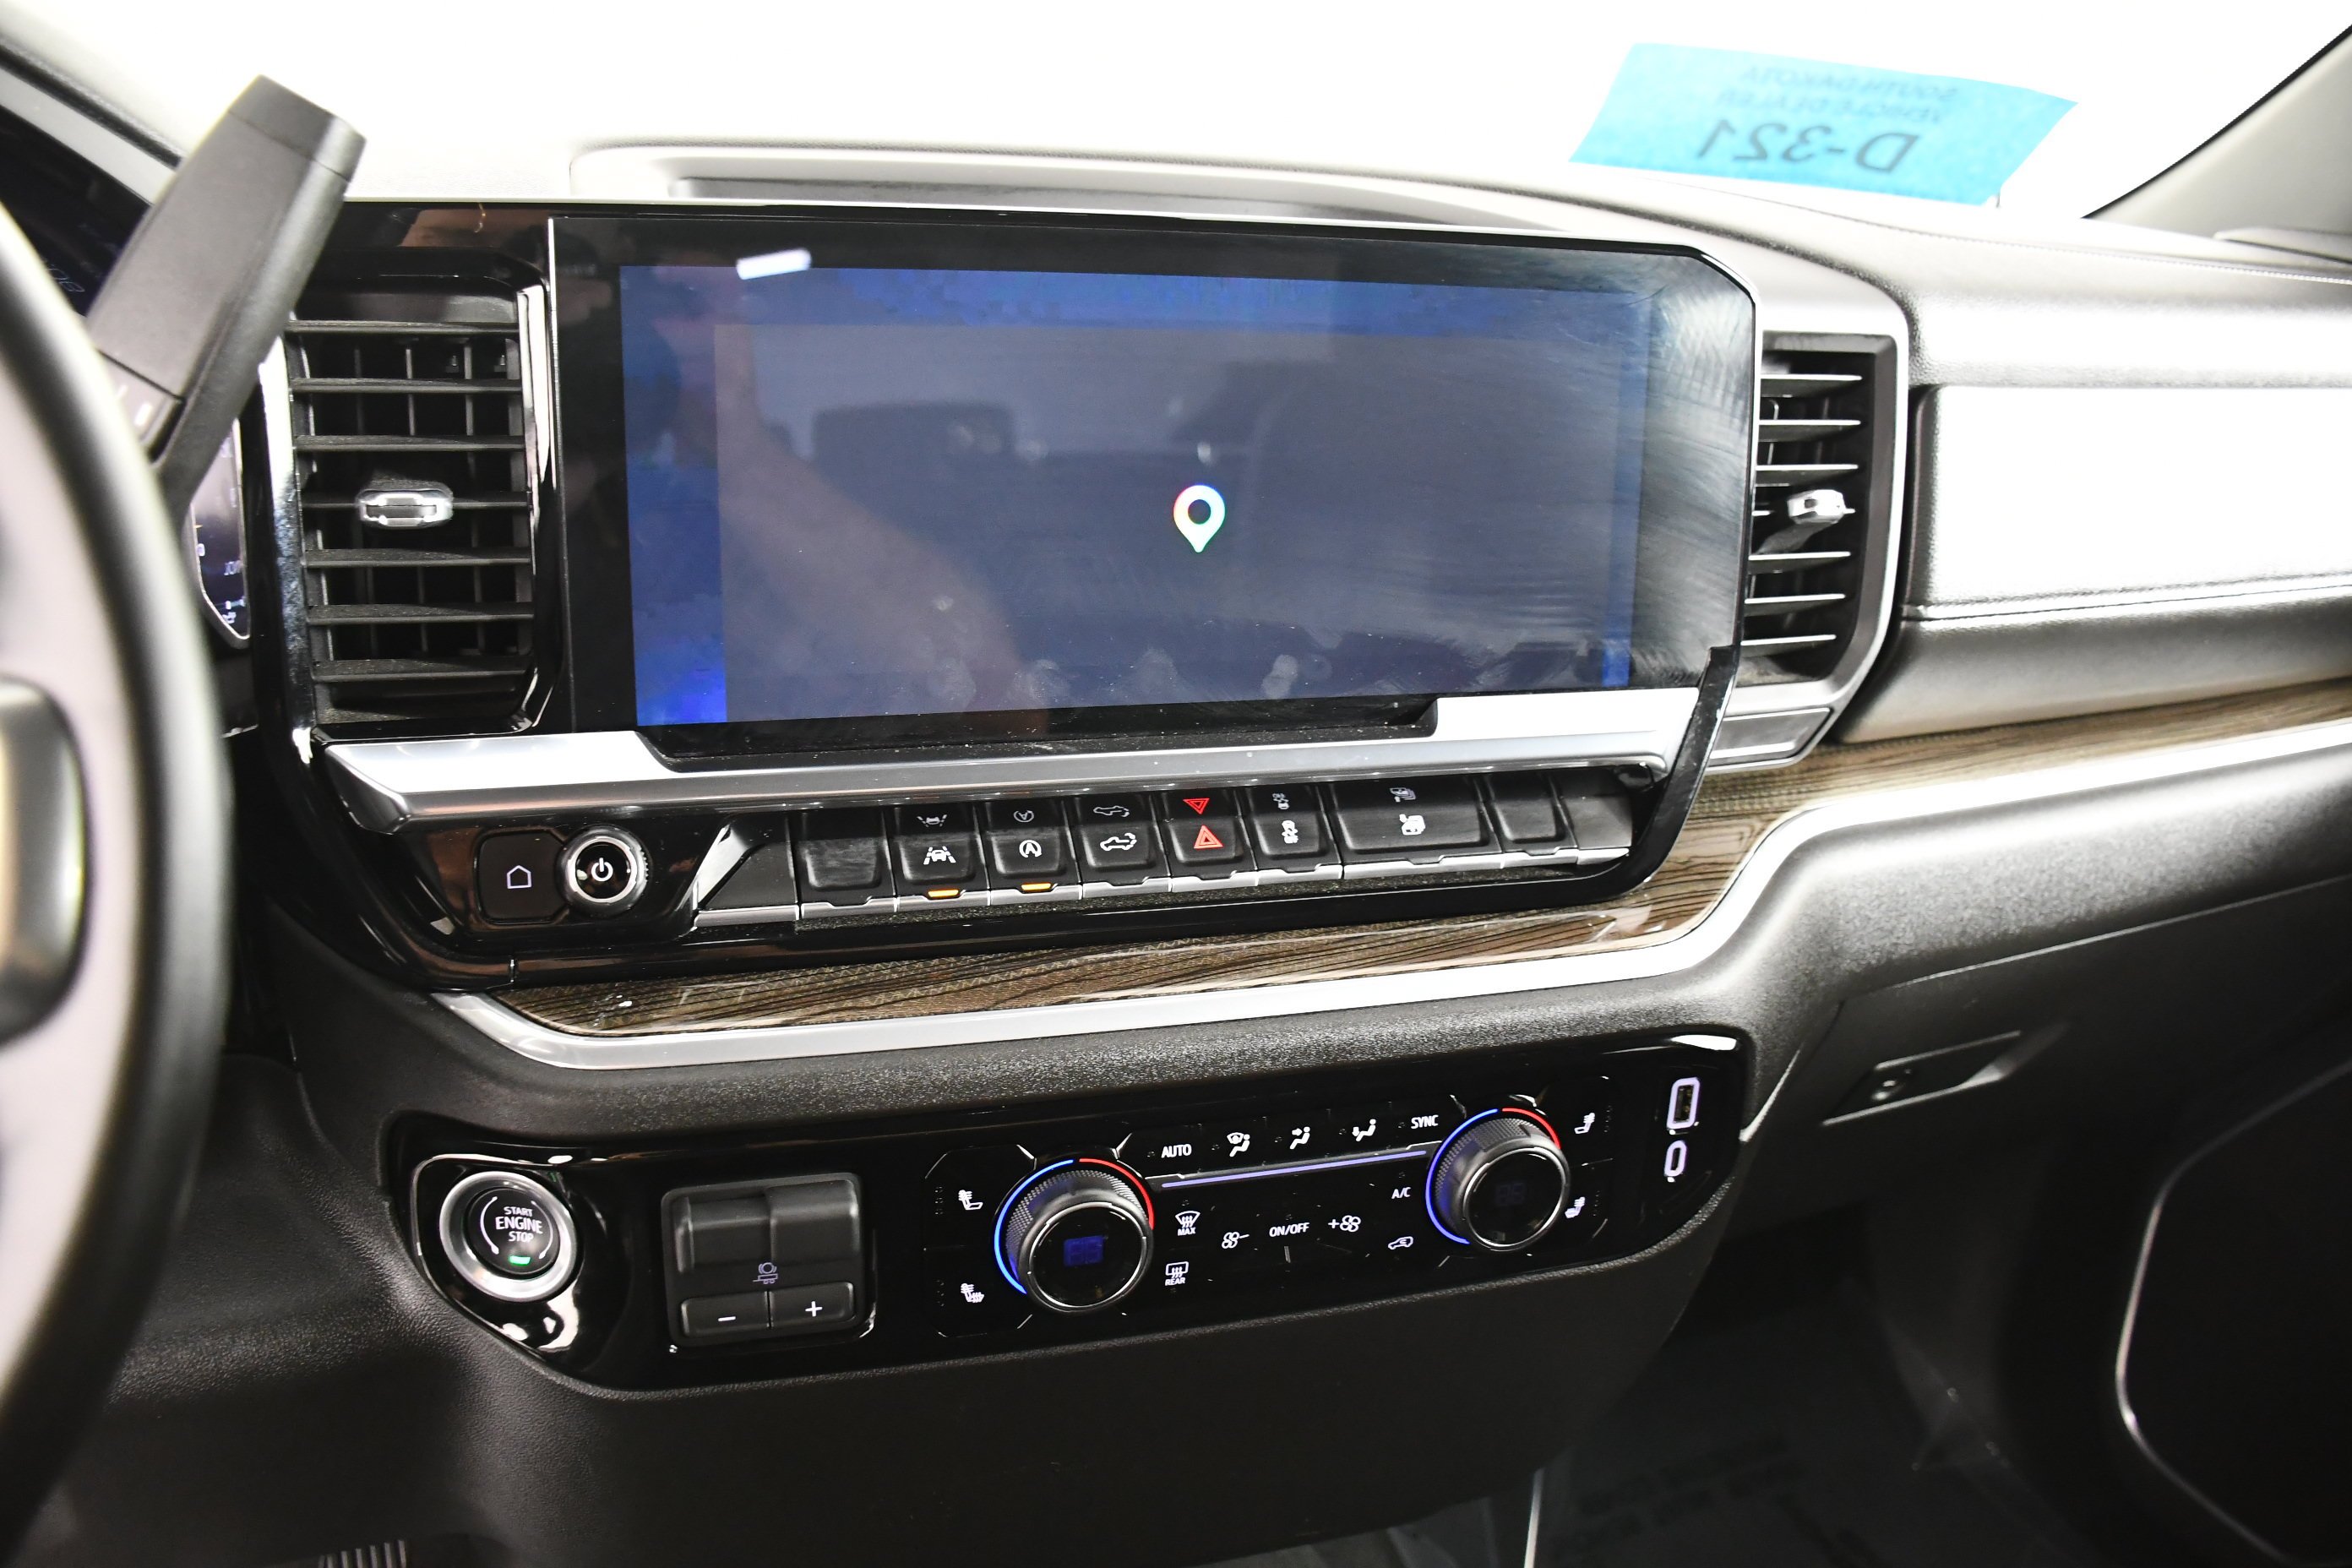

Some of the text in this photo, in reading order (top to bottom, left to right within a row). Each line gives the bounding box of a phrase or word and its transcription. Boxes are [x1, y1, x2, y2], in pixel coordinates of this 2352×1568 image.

[1411, 1115, 1438, 1129] SYNC
[1162, 1144, 1191, 1157] AUTO
[1391, 1187, 1411, 1199] A/C
[503, 1206, 532, 1217] START
[495, 1217, 543, 1234] ENGINE
[1178, 1227, 1195, 1236] MAX
[1269, 1222, 1309, 1237] ON/OFF
[509, 1232, 534, 1242] STOP
[1165, 1277, 1185, 1286] REAR
